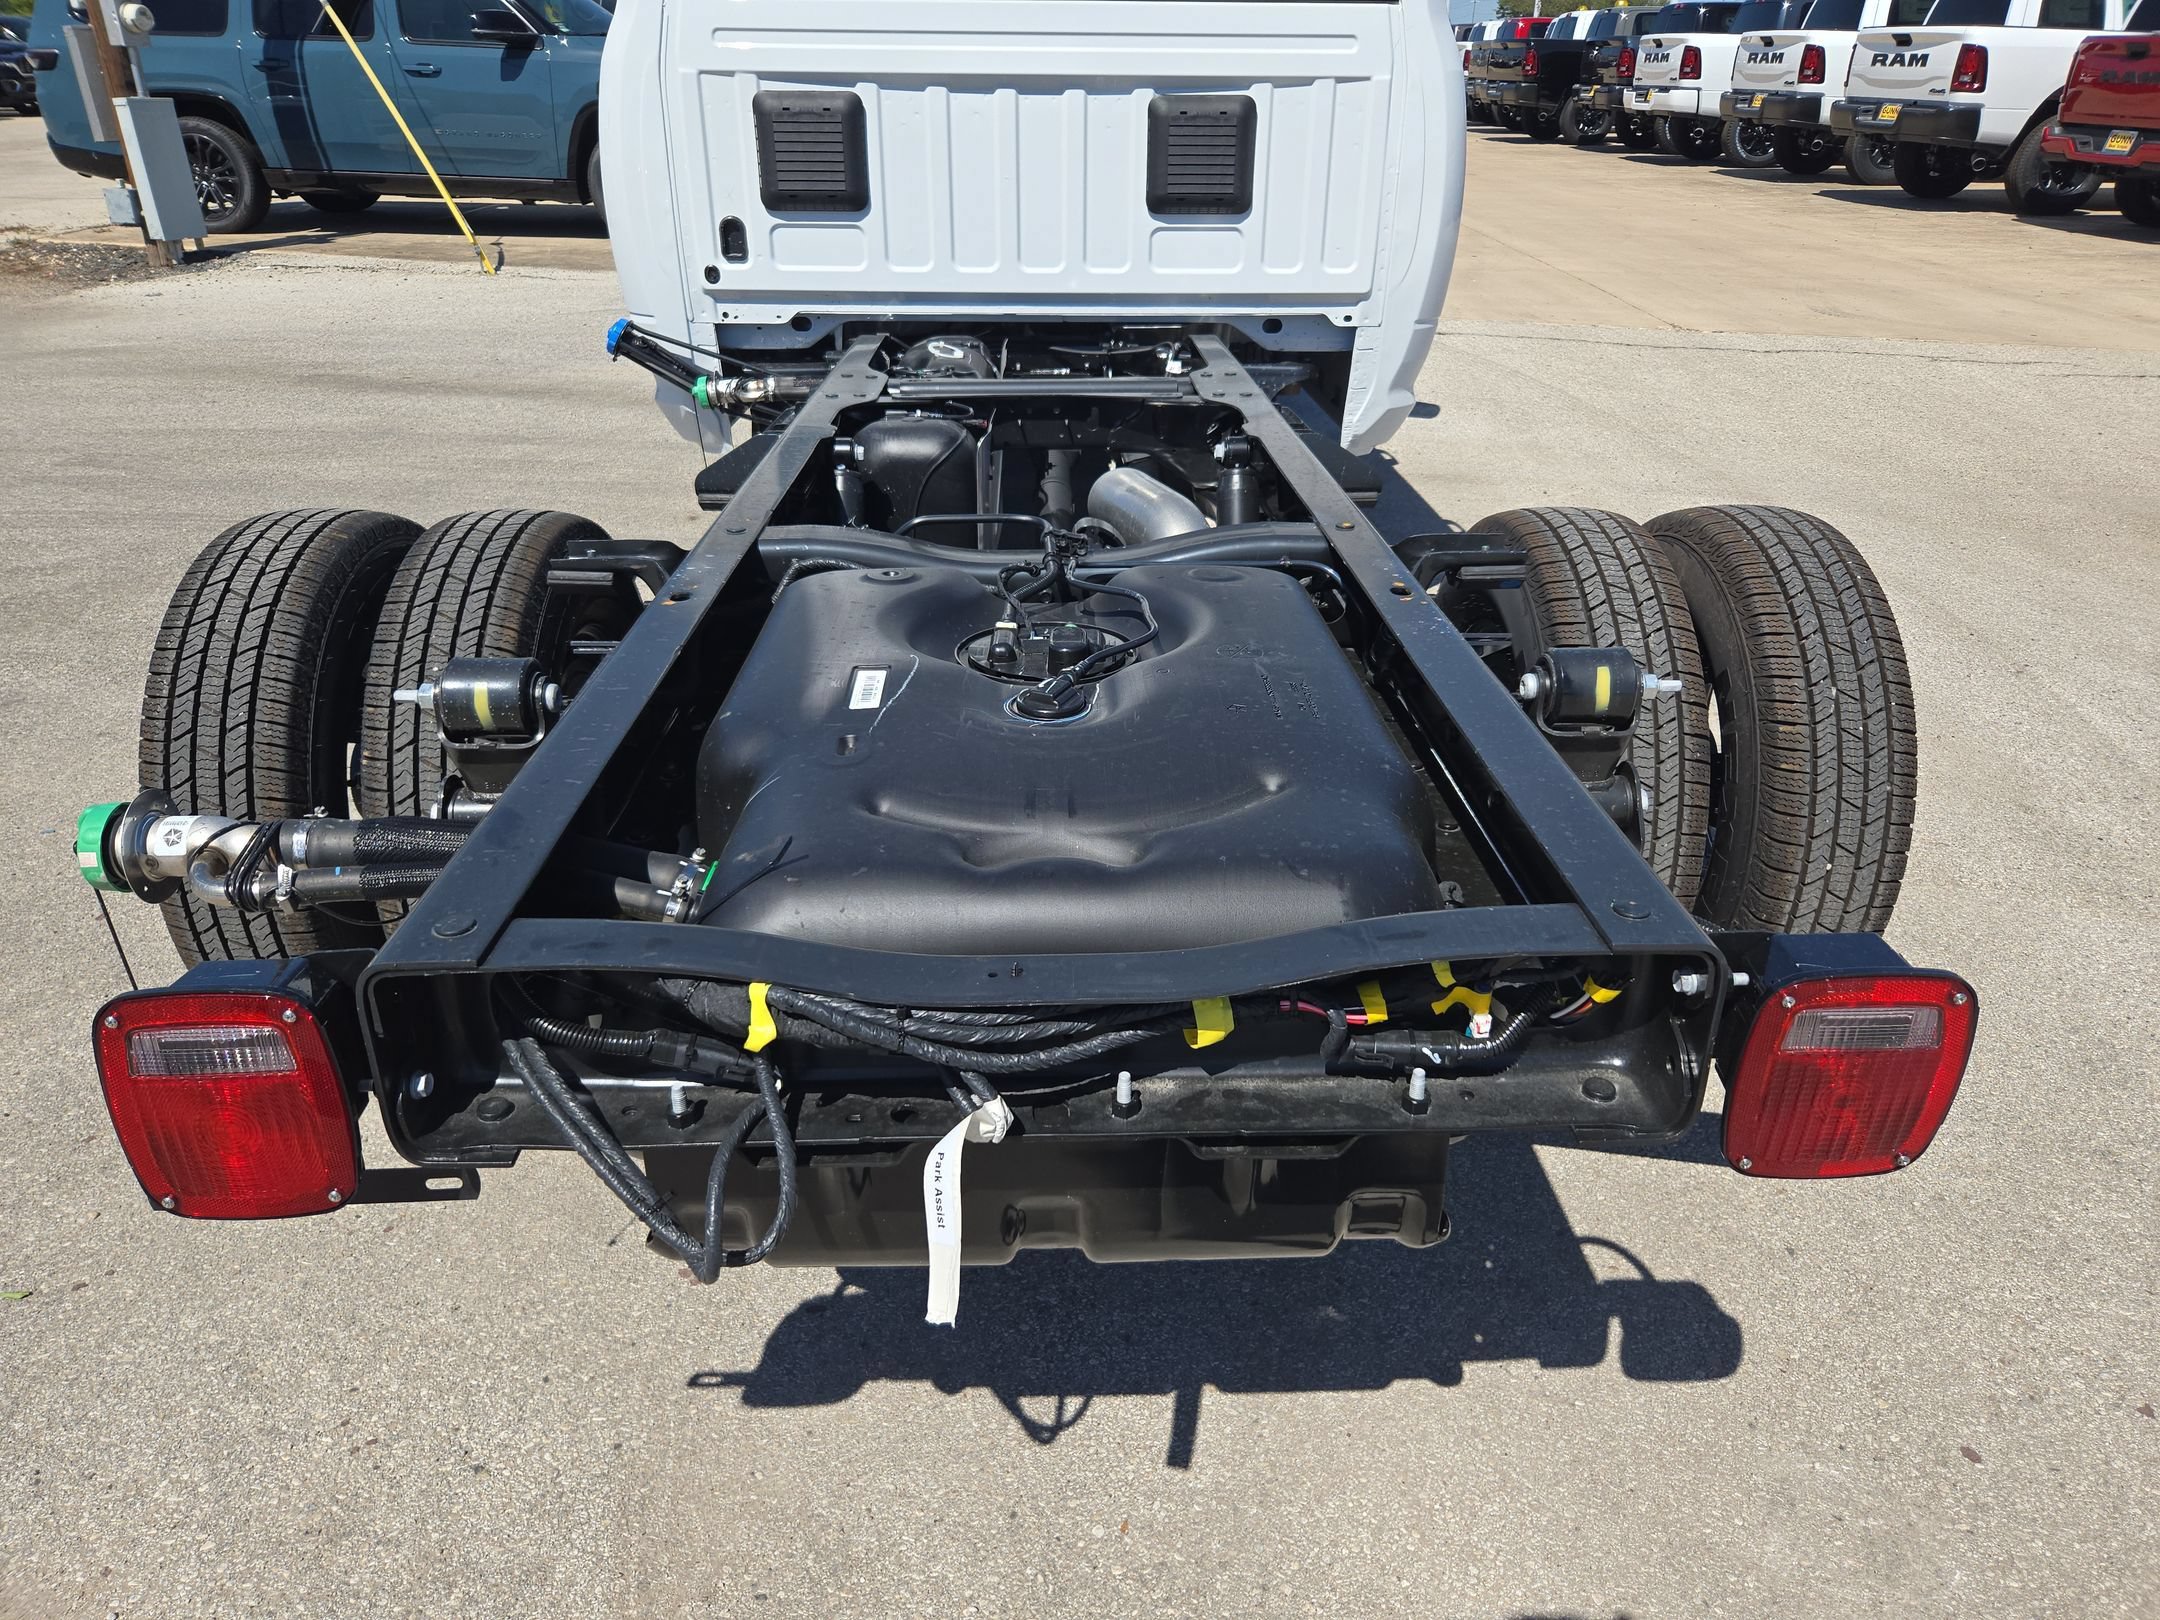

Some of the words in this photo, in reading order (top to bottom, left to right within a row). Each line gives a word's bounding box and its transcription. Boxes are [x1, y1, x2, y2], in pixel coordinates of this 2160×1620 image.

[1644, 53, 1670, 63] RAM
[1747, 52, 1785, 64] RAM
[1871, 53, 1930, 67] RAM
[2110, 134, 2135, 145] GUNN
[934, 1152, 945, 1183] Park
[934, 1187, 946, 1229] Assist
